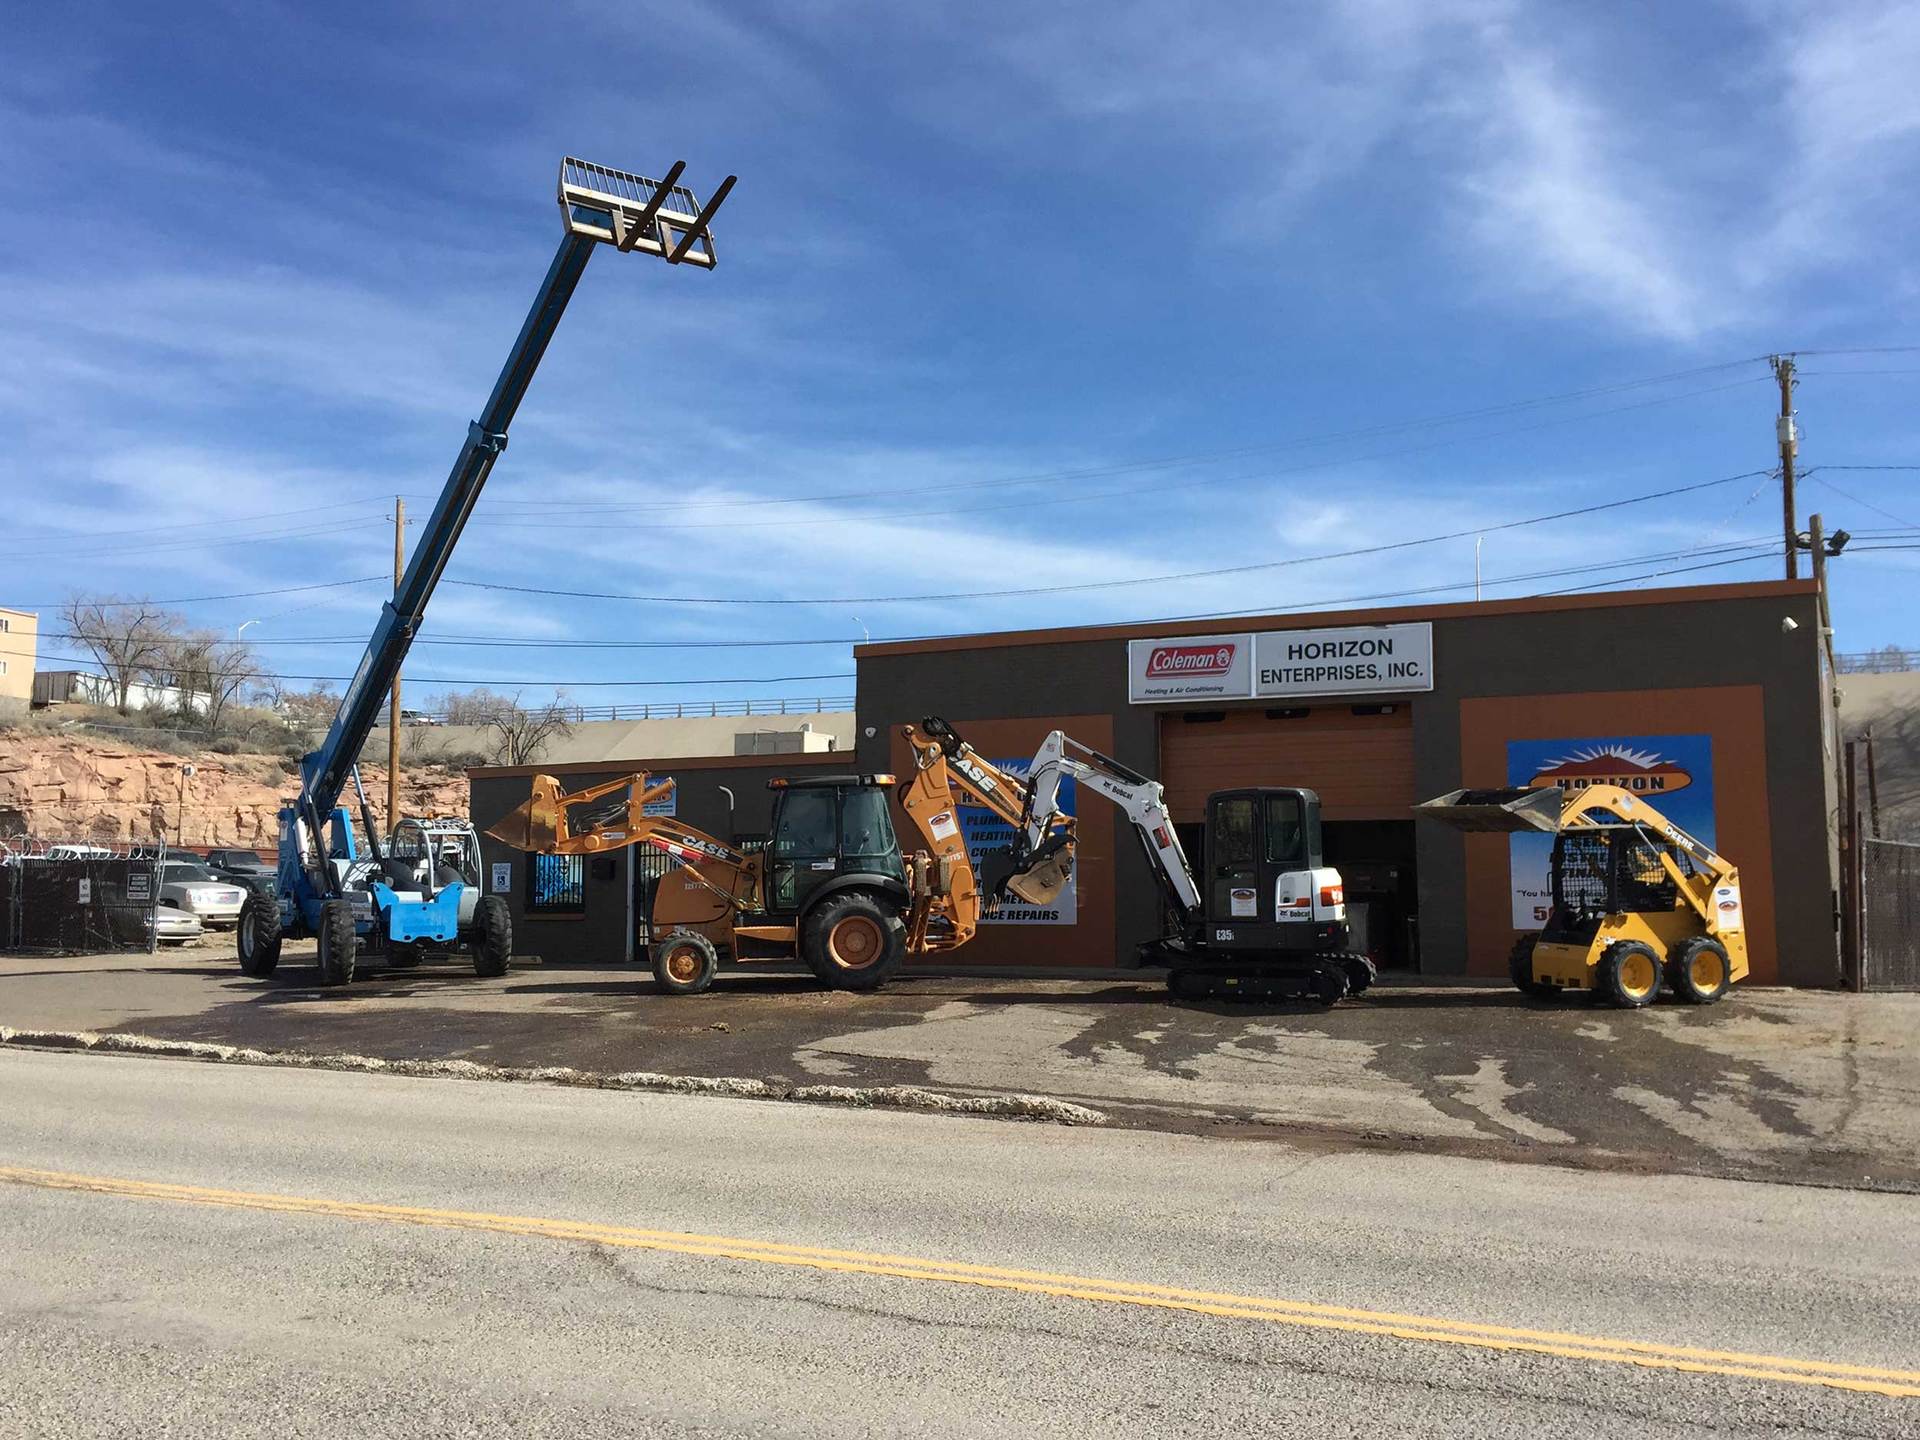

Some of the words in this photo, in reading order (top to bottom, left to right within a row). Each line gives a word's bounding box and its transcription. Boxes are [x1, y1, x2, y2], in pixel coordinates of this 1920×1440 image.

[1288, 638, 1393, 661] HORIZON
[1152, 650, 1215, 671] Coleman
[1260, 663, 1383, 684] ENTERPRISES,
[1387, 662, 1424, 678] INC.
[1112, 785, 1134, 800] Bobcat
[970, 831, 1015, 841] HEATIN
[682, 835, 728, 859] CASE
[1007, 910, 1060, 920] REPAIRS
[1289, 910, 1311, 918] Bobcat
